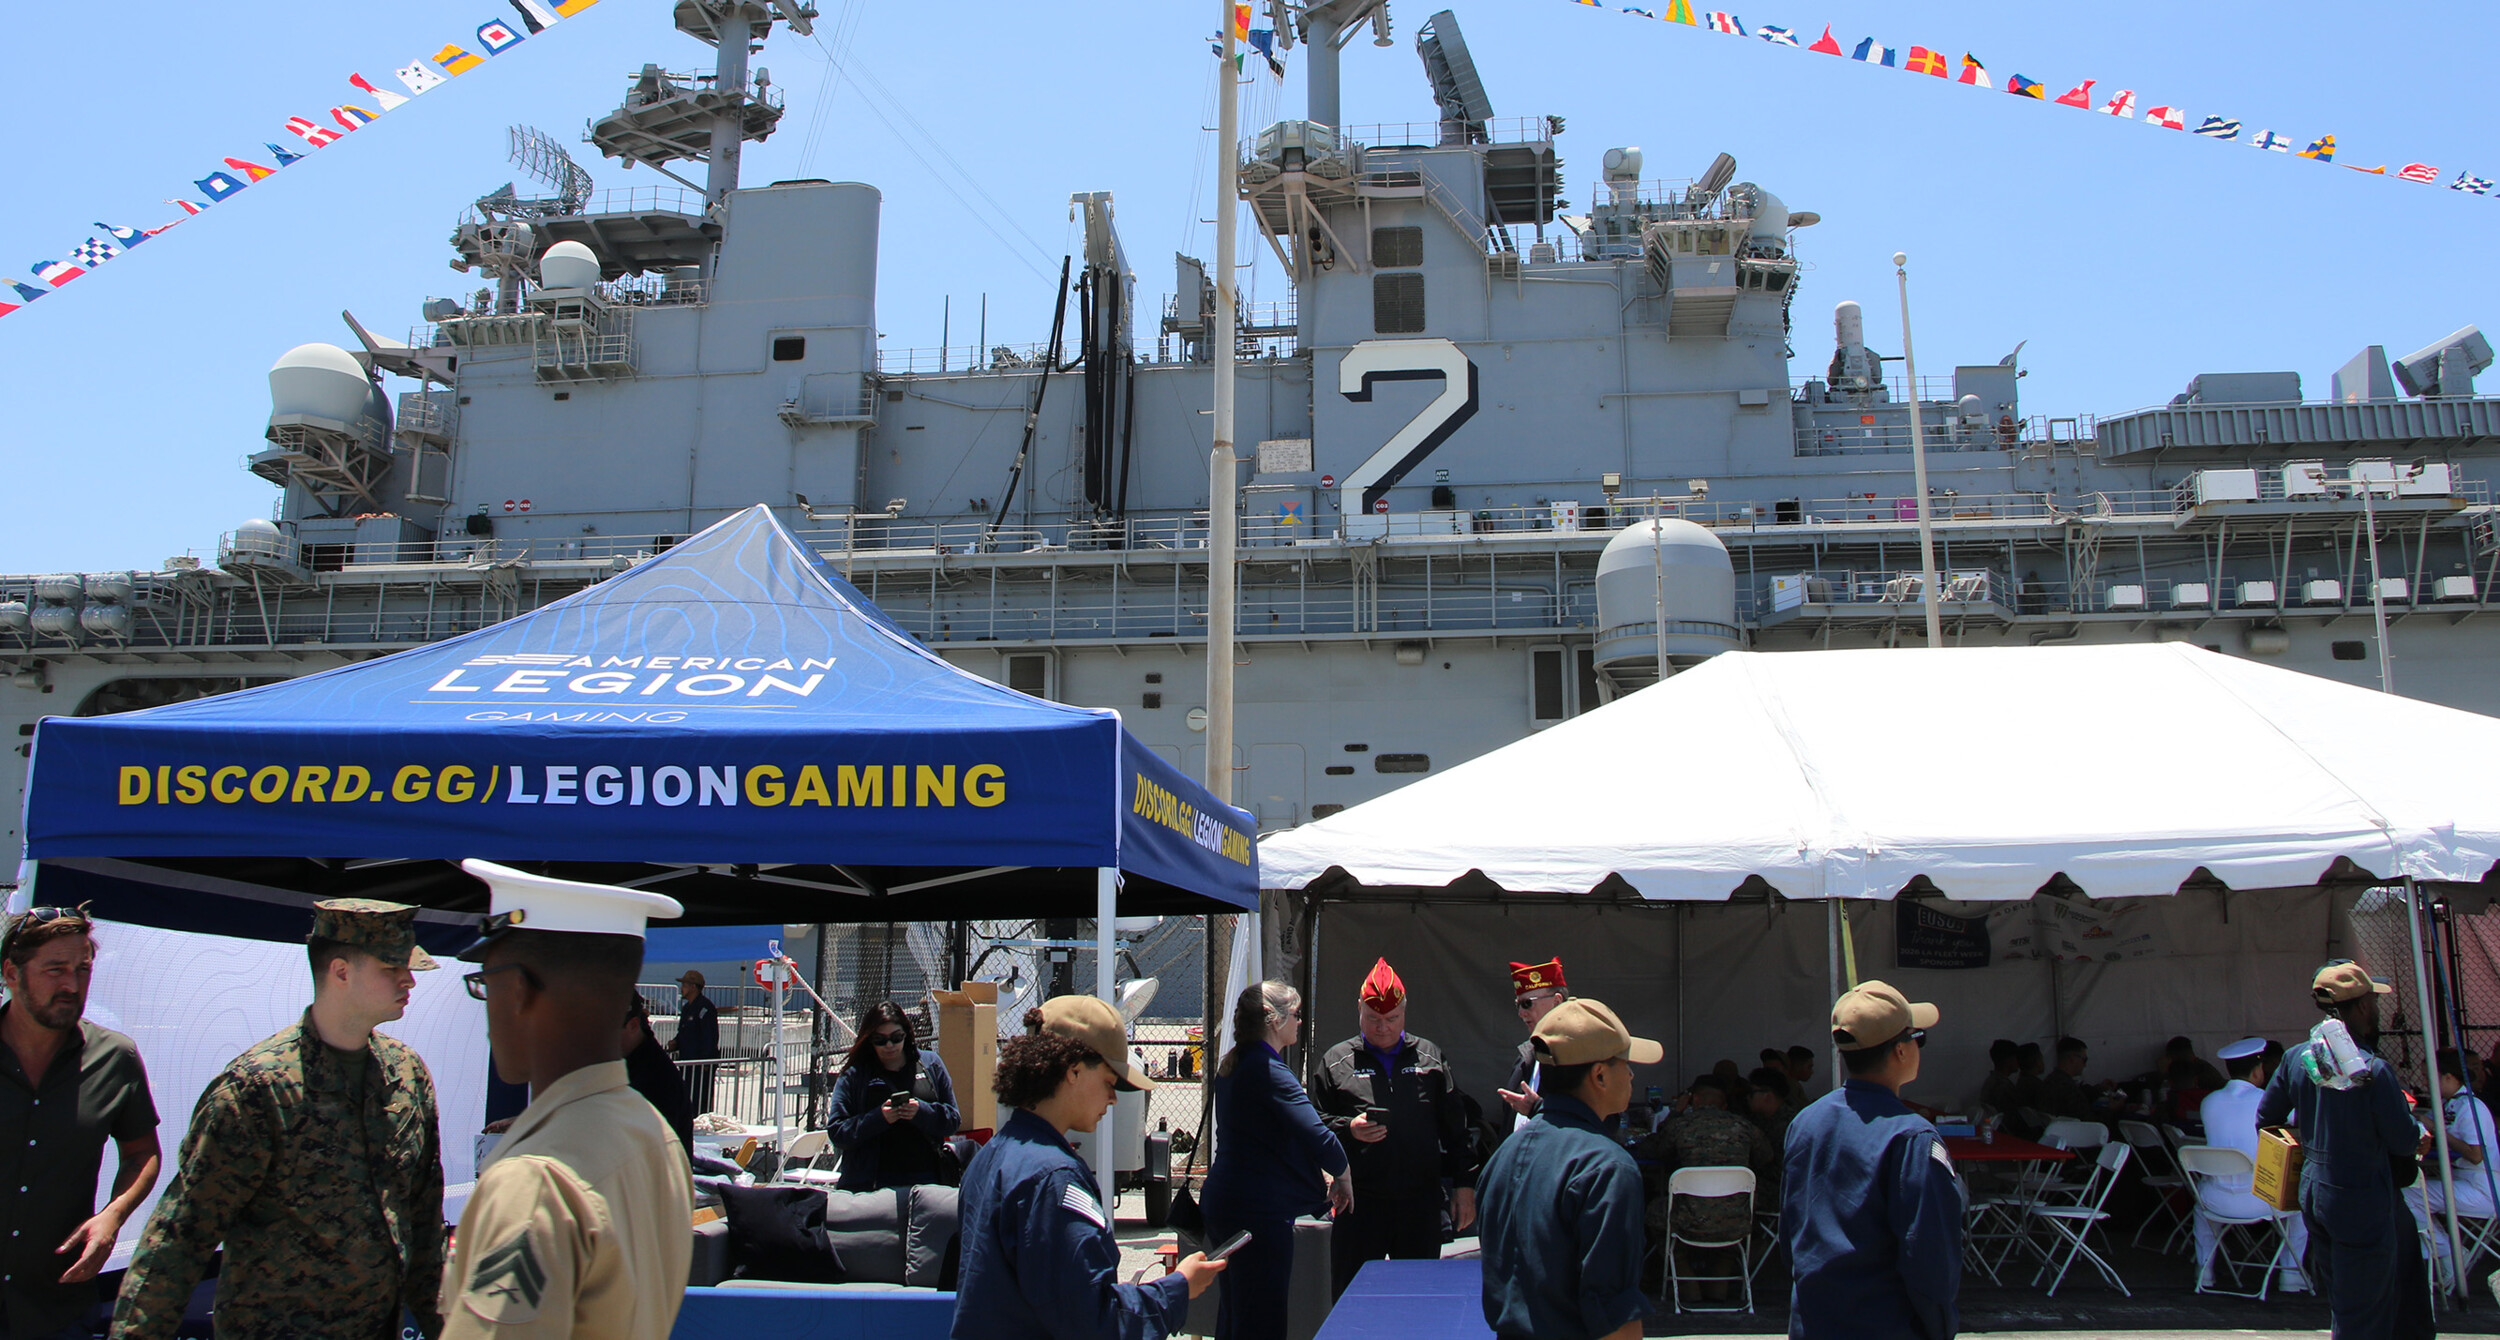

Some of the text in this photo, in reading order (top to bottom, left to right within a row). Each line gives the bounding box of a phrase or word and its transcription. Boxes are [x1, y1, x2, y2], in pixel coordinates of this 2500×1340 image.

[1339, 337, 1479, 535] 2
[563, 655, 838, 671] AMERICAN
[428, 669, 826, 698] LEGION
[465, 711, 689, 724] GAMING
[1919, 958, 1965, 967] SPONSORS
